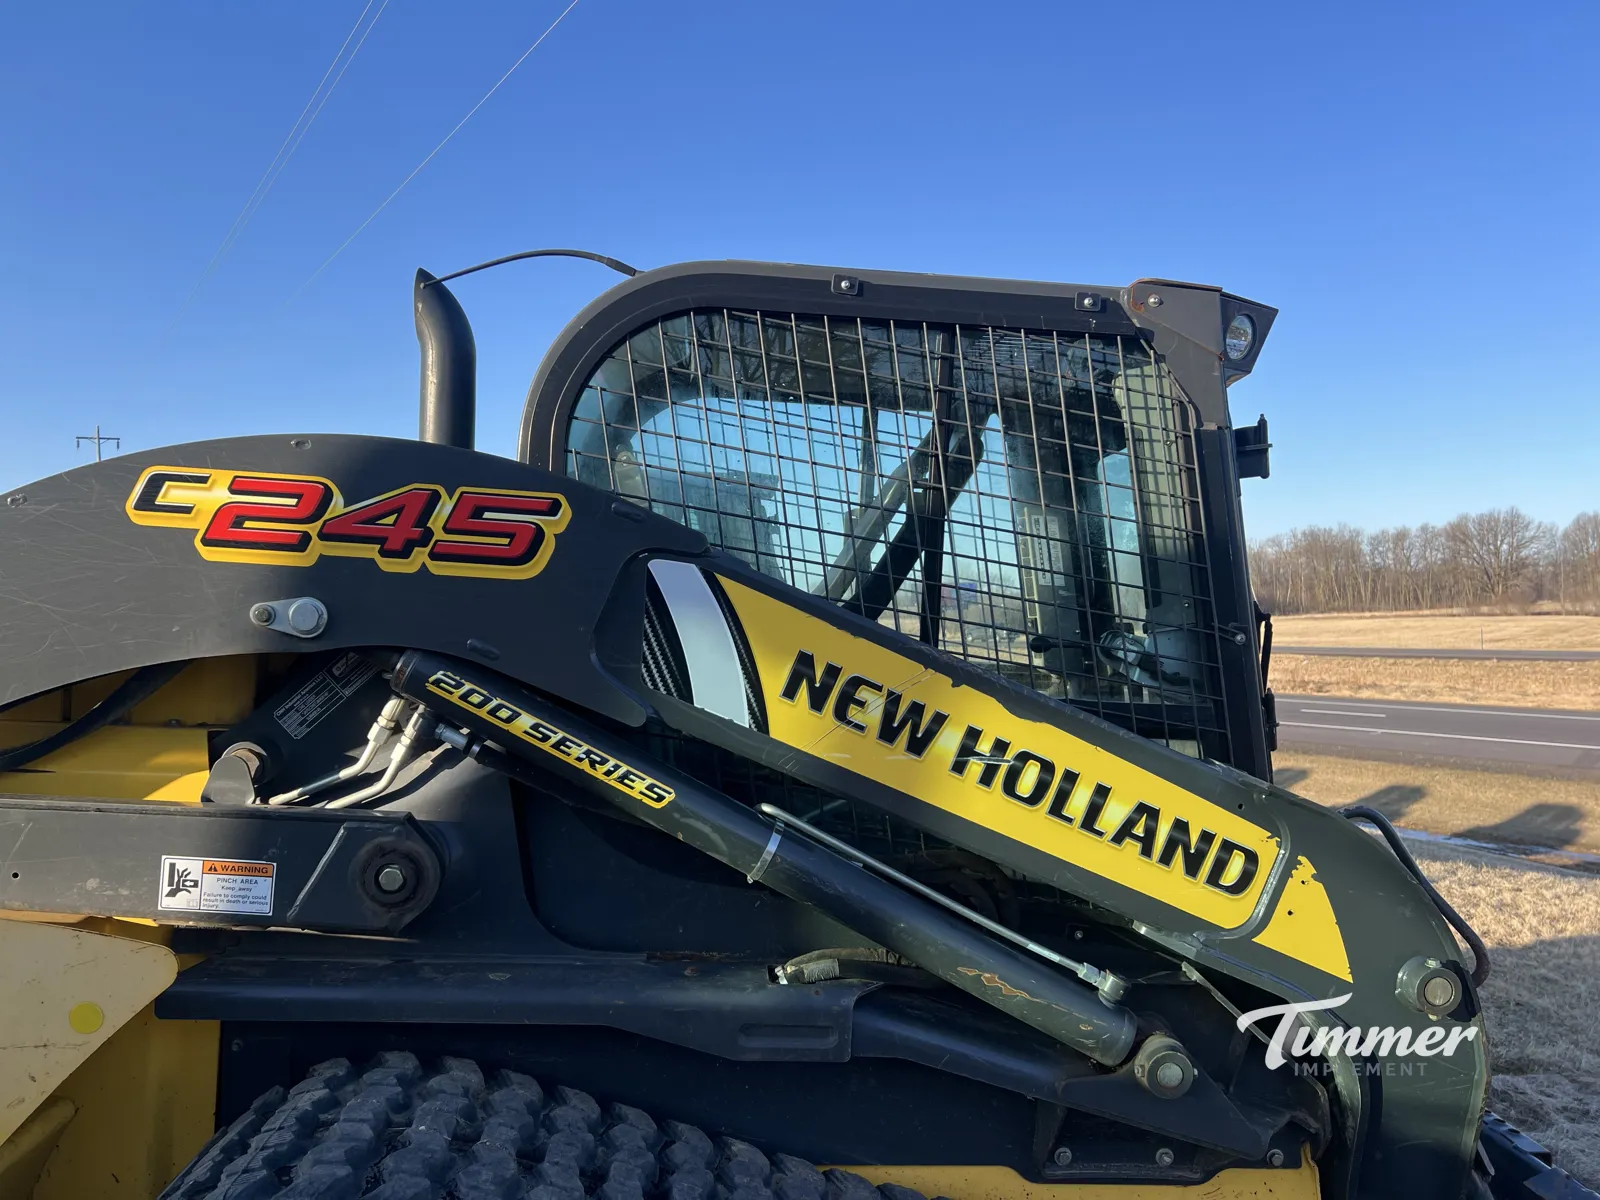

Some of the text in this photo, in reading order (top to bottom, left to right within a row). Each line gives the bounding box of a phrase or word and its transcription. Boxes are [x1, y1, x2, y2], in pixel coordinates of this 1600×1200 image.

[129, 469, 564, 568] C245
[426, 671, 522, 725] 200
[522, 722, 675, 804] SERIES
[780, 649, 1260, 897] NEW HOLLAND
[220, 865, 268, 874] WARNING
